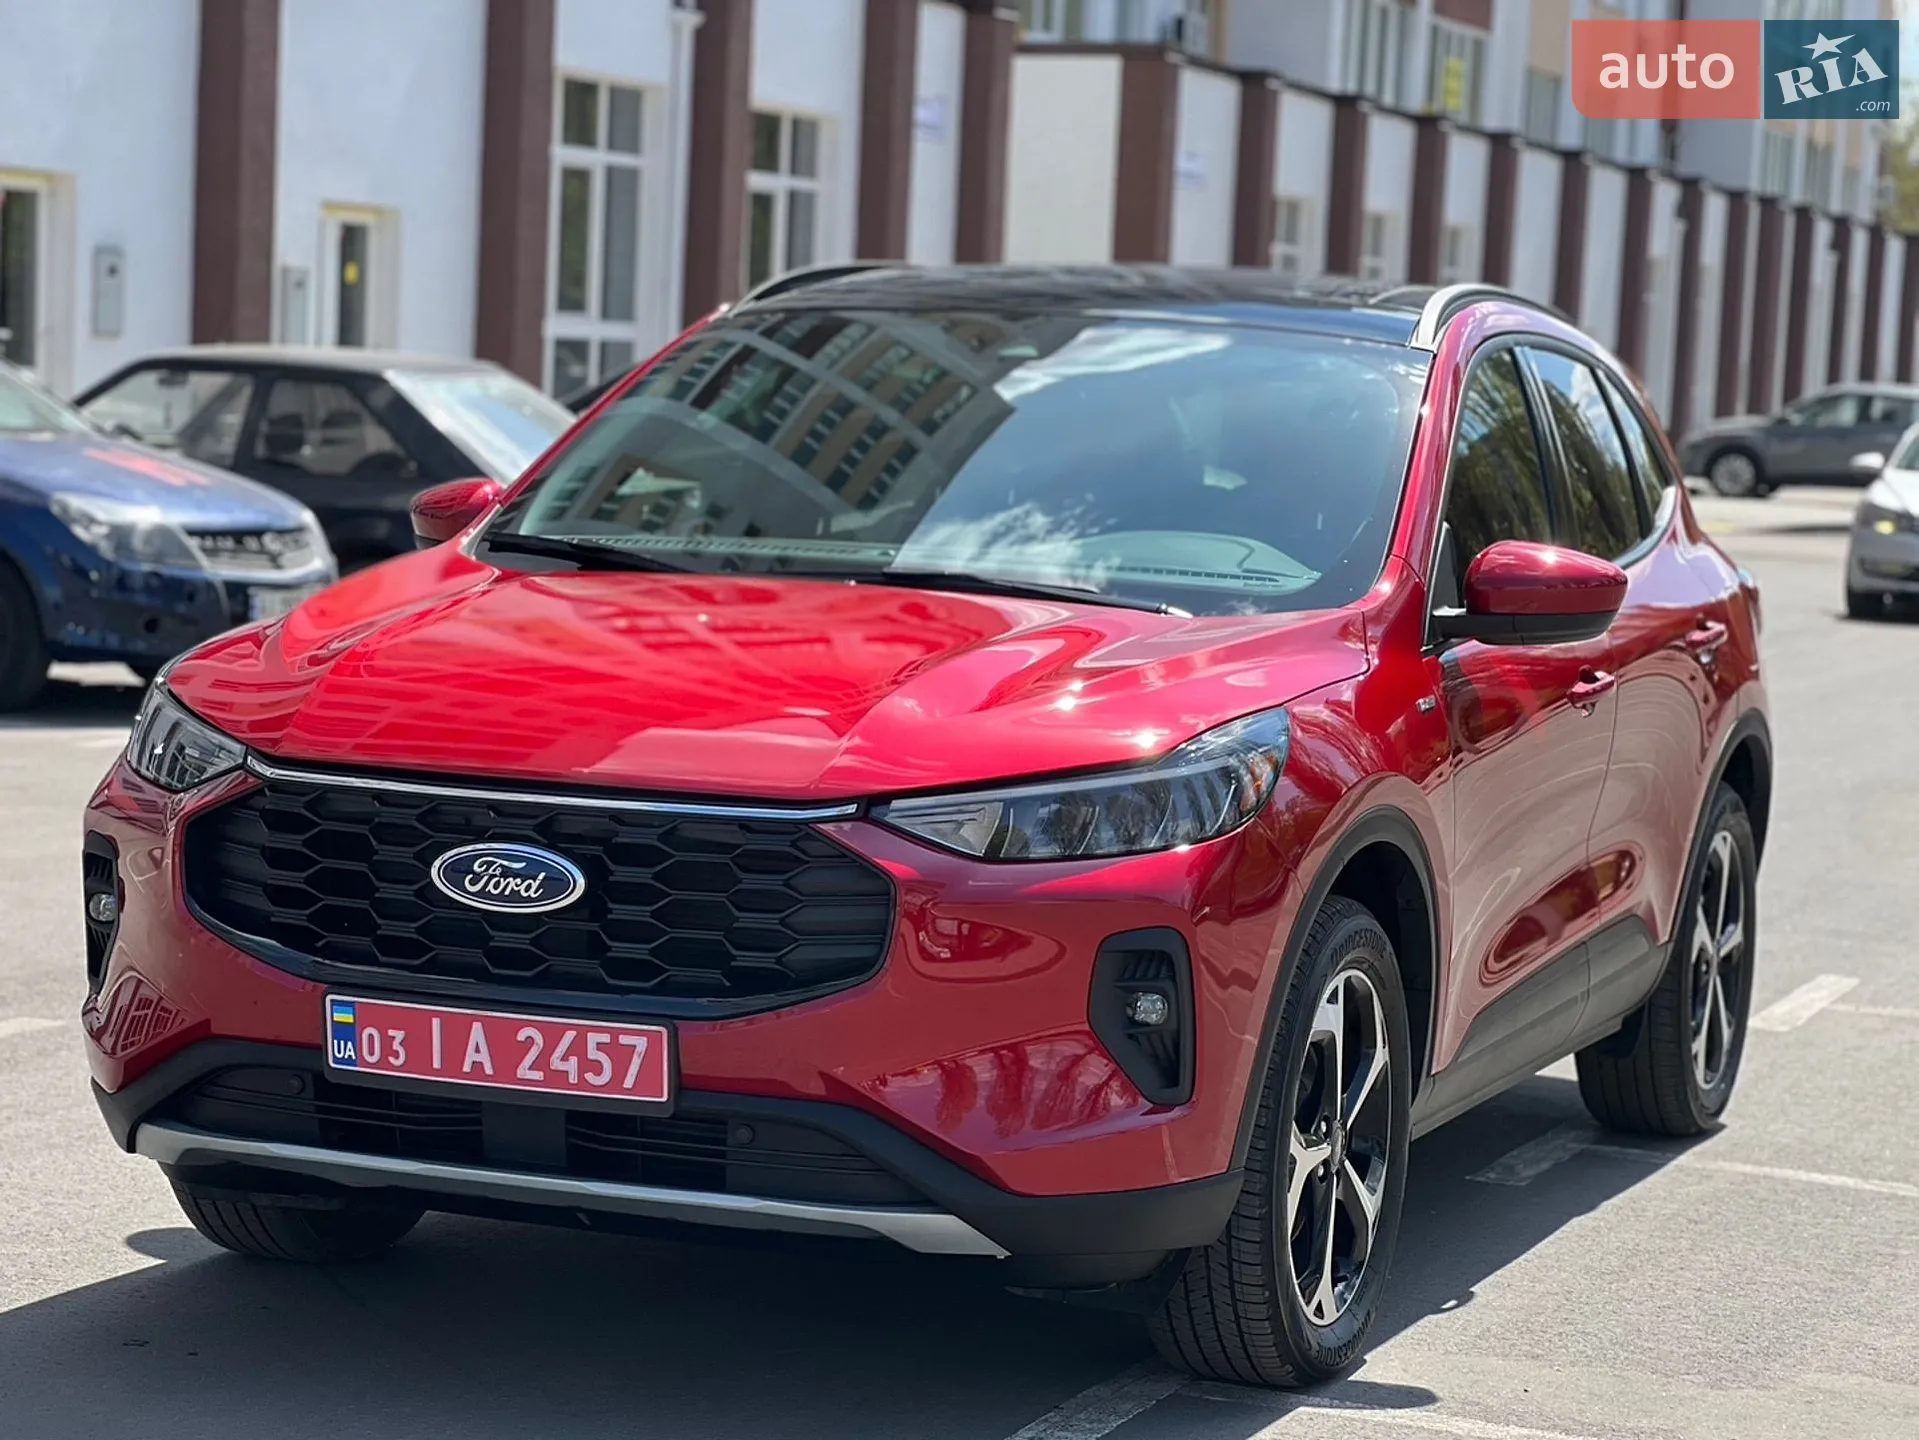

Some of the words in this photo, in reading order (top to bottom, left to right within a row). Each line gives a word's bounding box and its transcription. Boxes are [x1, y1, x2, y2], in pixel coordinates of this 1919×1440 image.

[464, 857, 546, 898] Ford
[334, 1039, 356, 1060] UA
[361, 1026, 405, 1067] 03
[516, 1027, 648, 1089] 2457
